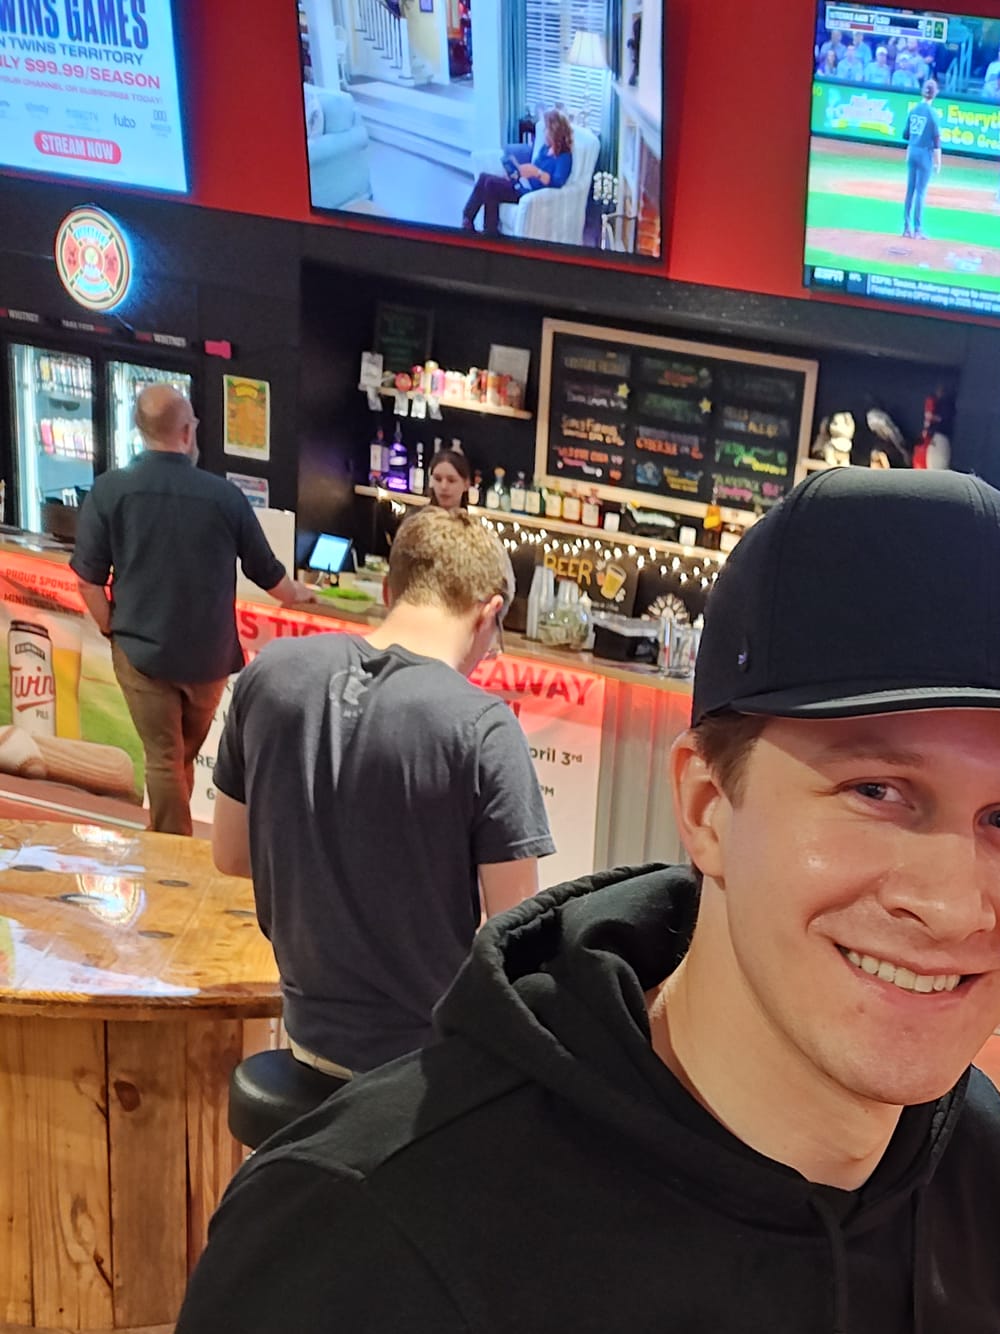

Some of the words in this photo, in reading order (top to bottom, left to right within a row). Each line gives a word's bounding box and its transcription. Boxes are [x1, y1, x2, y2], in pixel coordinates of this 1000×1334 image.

[0, 0, 60, 39] WINS
[64, 0, 149, 50] GAMES
[7, 36, 56, 54] TWINS
[59, 43, 143, 66] TERRITORY
[25, 57, 160, 89] $99.99/SEASON
[909, 114, 926, 136] 27
[41, 134, 86, 157] STREAM
[87, 142, 113, 160] NOW
[6, 569, 37, 585] PROUD
[39, 576, 78, 593] SPONSO
[544, 553, 593, 586] BEER
[468, 660, 595, 706] EAWAY
